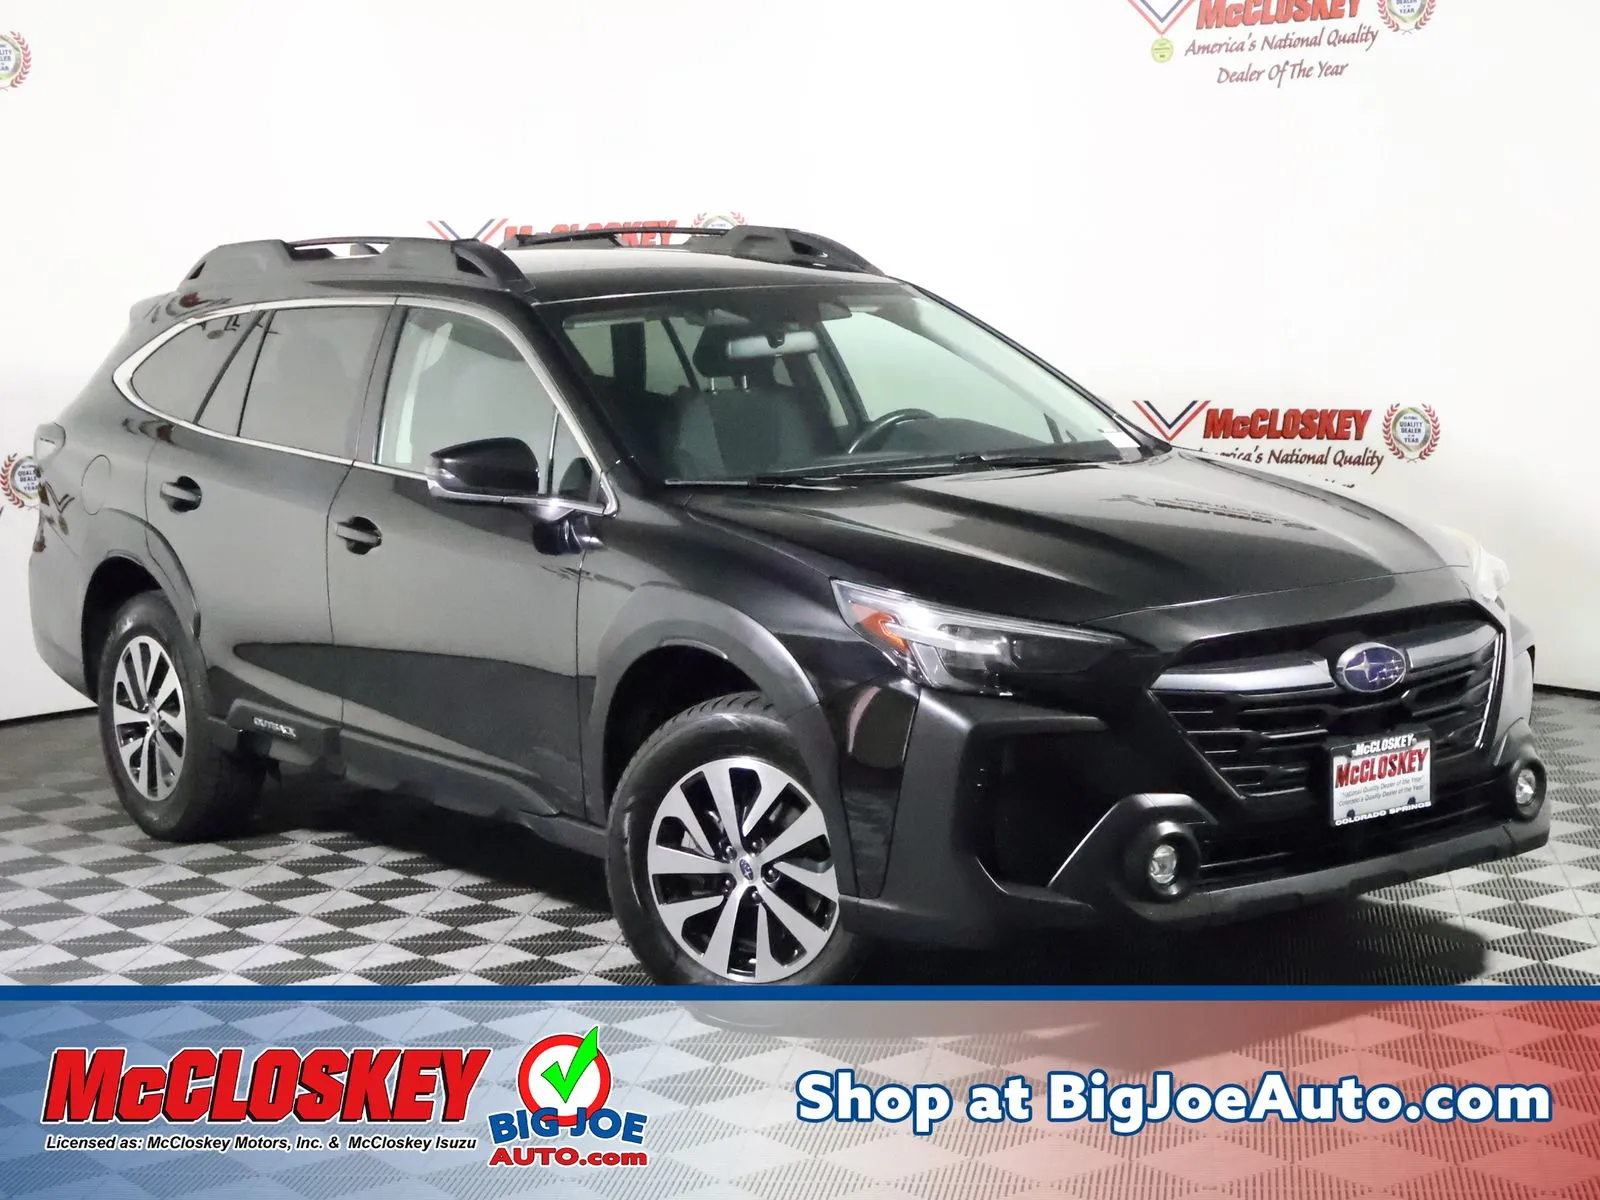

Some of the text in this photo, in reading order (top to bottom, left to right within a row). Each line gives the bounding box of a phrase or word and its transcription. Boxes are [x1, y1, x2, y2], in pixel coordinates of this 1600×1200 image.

[1184, 32, 1257, 56] America's
[1261, 26, 1326, 50] National
[1327, 23, 1380, 51] Quality
[1217, 59, 1349, 88] Dealer Of The Year
[1203, 408, 1372, 440] McCLOSKEY
[1267, 446, 1332, 465] National
[1333, 447, 1384, 475] Quality
[1352, 733, 1415, 756] McCLOSKEY
[1335, 748, 1429, 788] McCLOSKEY
[1335, 801, 1431, 826] COLORADO SPRINGS
